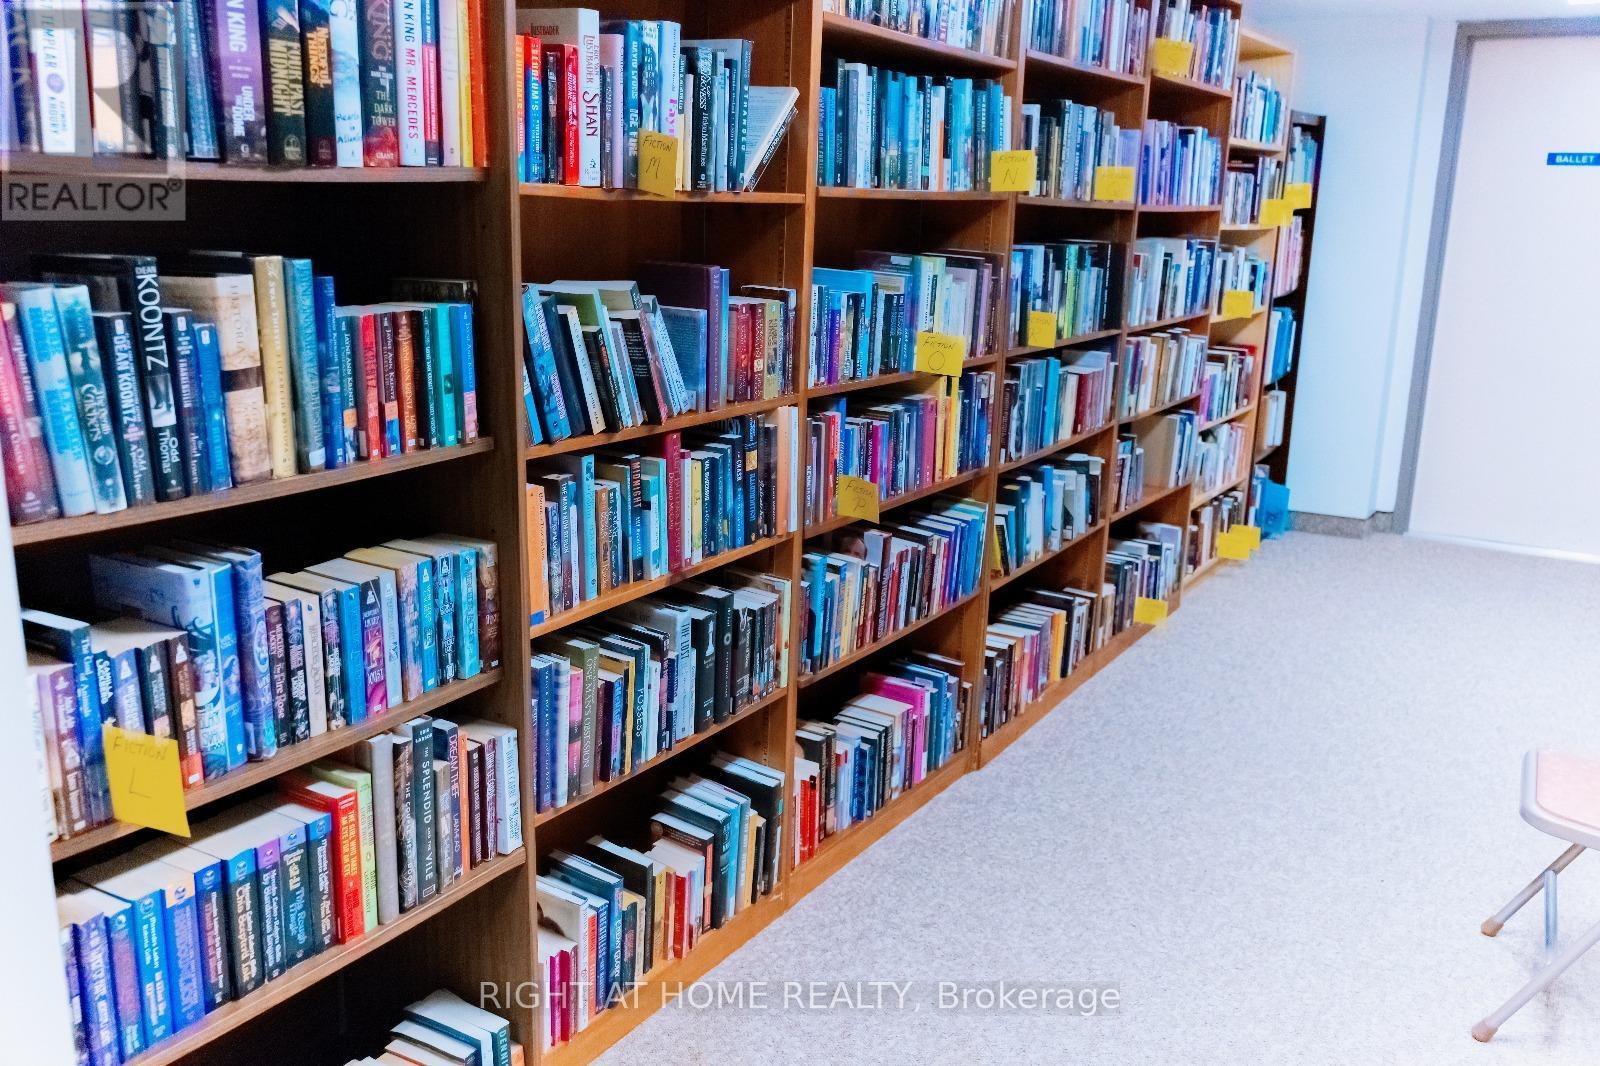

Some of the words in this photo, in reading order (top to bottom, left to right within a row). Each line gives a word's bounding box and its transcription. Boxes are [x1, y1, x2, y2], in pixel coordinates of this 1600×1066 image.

[229, 14, 247, 53] KING
[403, 13, 415, 42] KING
[288, 42, 301, 82] FOUR
[306, 31, 323, 84] THINGS
[314, 26, 331, 88] NEEDFUL
[405, 48, 416, 66] MR
[584, 34, 596, 84] LUSTBADER
[630, 40, 638, 69] DAVID
[269, 38, 292, 117] MIDNIGHT
[630, 70, 638, 100] LYONS
[241, 85, 256, 121] UNDER
[291, 81, 305, 117] PAST
[374, 103, 393, 113] DARK
[375, 90, 390, 100] THE
[406, 76, 419, 140] MERCEDES
[231, 105, 246, 137] DOME
[371, 115, 396, 126] TOWER
[582, 90, 599, 137] SHAN
[629, 108, 639, 128] ICE
[701, 111, 709, 132] Helen
[629, 131, 639, 157] FIRE
[700, 132, 708, 167] MacInnes
[1003, 168, 1019, 185] N
[135, 265, 157, 275] DEAN
[137, 274, 169, 370] KOONTZ
[114, 335, 129, 370] DEAN
[385, 329, 393, 349] JAYNE
[927, 351, 946, 371] O
[119, 373, 136, 425] KOONTZ
[178, 358, 191, 408] FRANKENSTEIN
[158, 430, 171, 474] Thomas
[168, 437, 180, 463] Odd
[632, 461, 642, 508] MIDNIGHT
[269, 629, 278, 655] LACKEY
[274, 623, 284, 658] MERCEDES
[681, 623, 690, 637] THE
[681, 640, 690, 659] LOST
[273, 674, 286, 694] Fire
[585, 658, 594, 680] ONE
[80, 683, 92, 717] Animals
[274, 693, 287, 719] Rose
[584, 683, 593, 715] MAN'S
[635, 688, 645, 738] POSSESS
[113, 735, 168, 761] FICTION
[449, 734, 459, 772] DREAM
[583, 717, 592, 769] OBSESSION
[128, 766, 153, 799] L
[422, 760, 432, 824] SPLENDID
[450, 773, 460, 799] THIEF
[341, 815, 348, 826] AN
[405, 800, 413, 833] COUPLE
[343, 852, 350, 863] AN
[424, 851, 434, 881] VILE
[289, 903, 298, 936] Magic
[297, 911, 307, 945] Rough
[499, 1029, 509, 1066] DENNI
